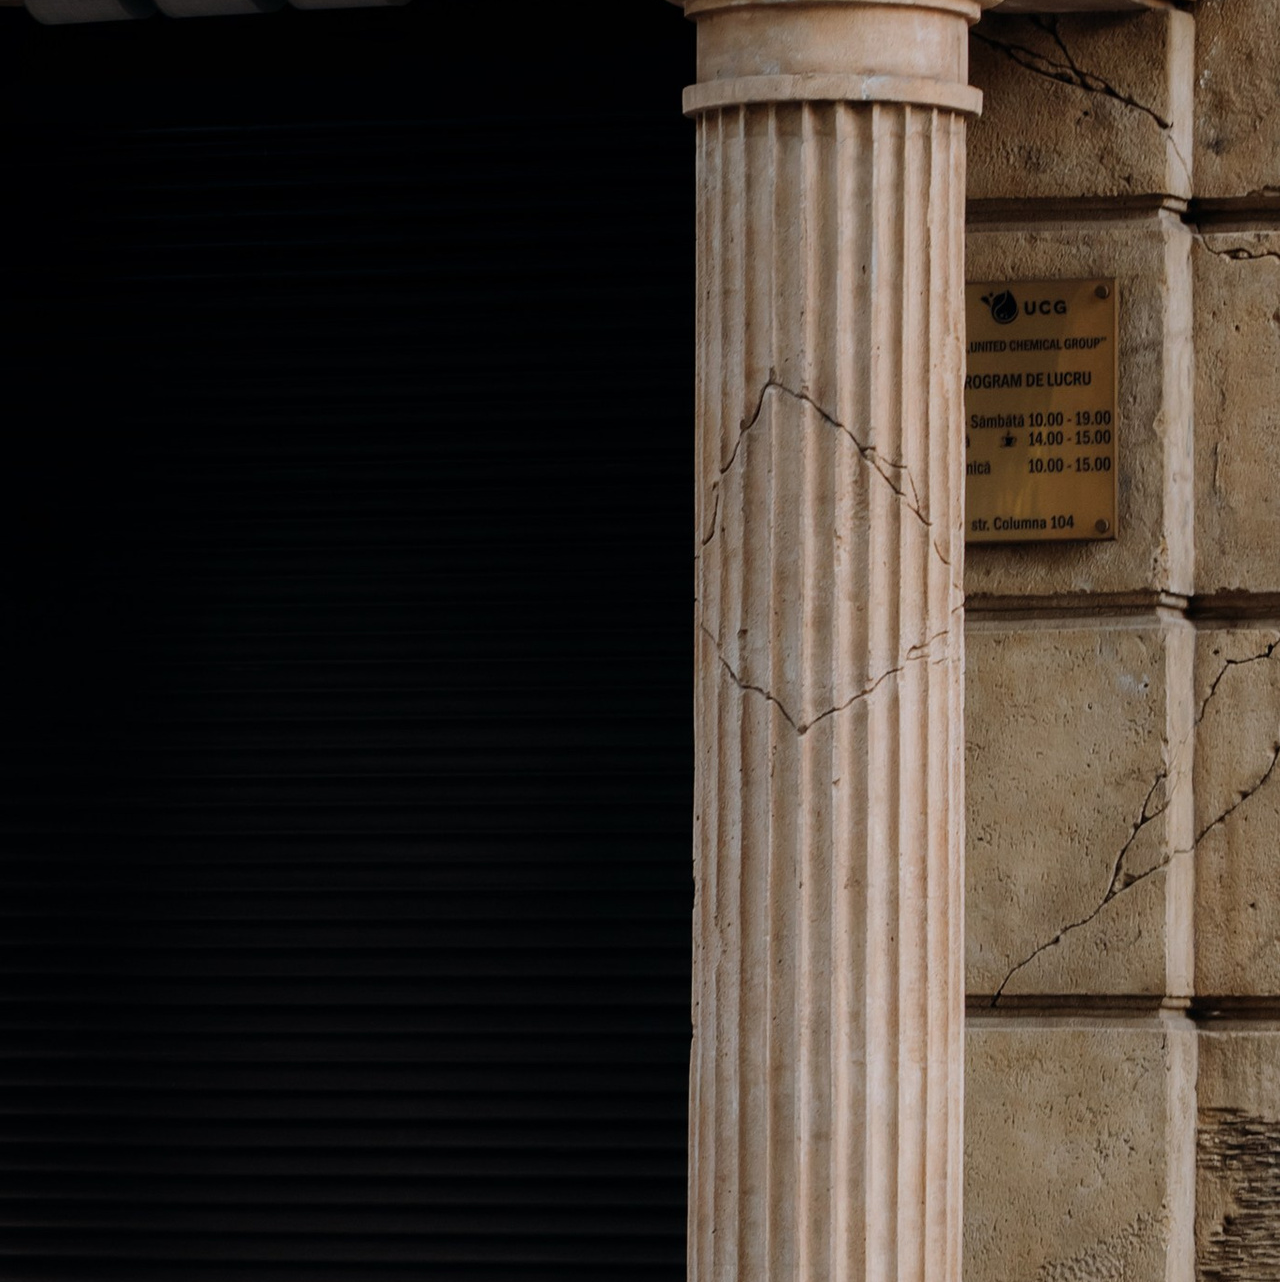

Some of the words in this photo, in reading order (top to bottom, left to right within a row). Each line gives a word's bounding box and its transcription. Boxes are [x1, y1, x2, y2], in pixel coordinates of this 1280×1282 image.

[1024, 300, 1067, 315] UCG
[1009, 338, 1061, 352] CHEMICAL
[965, 373, 1022, 390] ROGRAM
[1026, 372, 1044, 387] DE
[1047, 371, 1092, 387] LUCRU
[1029, 412, 1064, 427] 10.00
[1075, 410, 1111, 426] 19.00
[1029, 431, 1064, 446] 14.00
[1075, 429, 1111, 445] 15.00
[1029, 457, 1064, 473] 10.00
[1075, 456, 1111, 472] 15.00
[971, 519, 990, 532] str.
[993, 516, 1047, 530] Columna
[1050, 515, 1074, 529] 104
